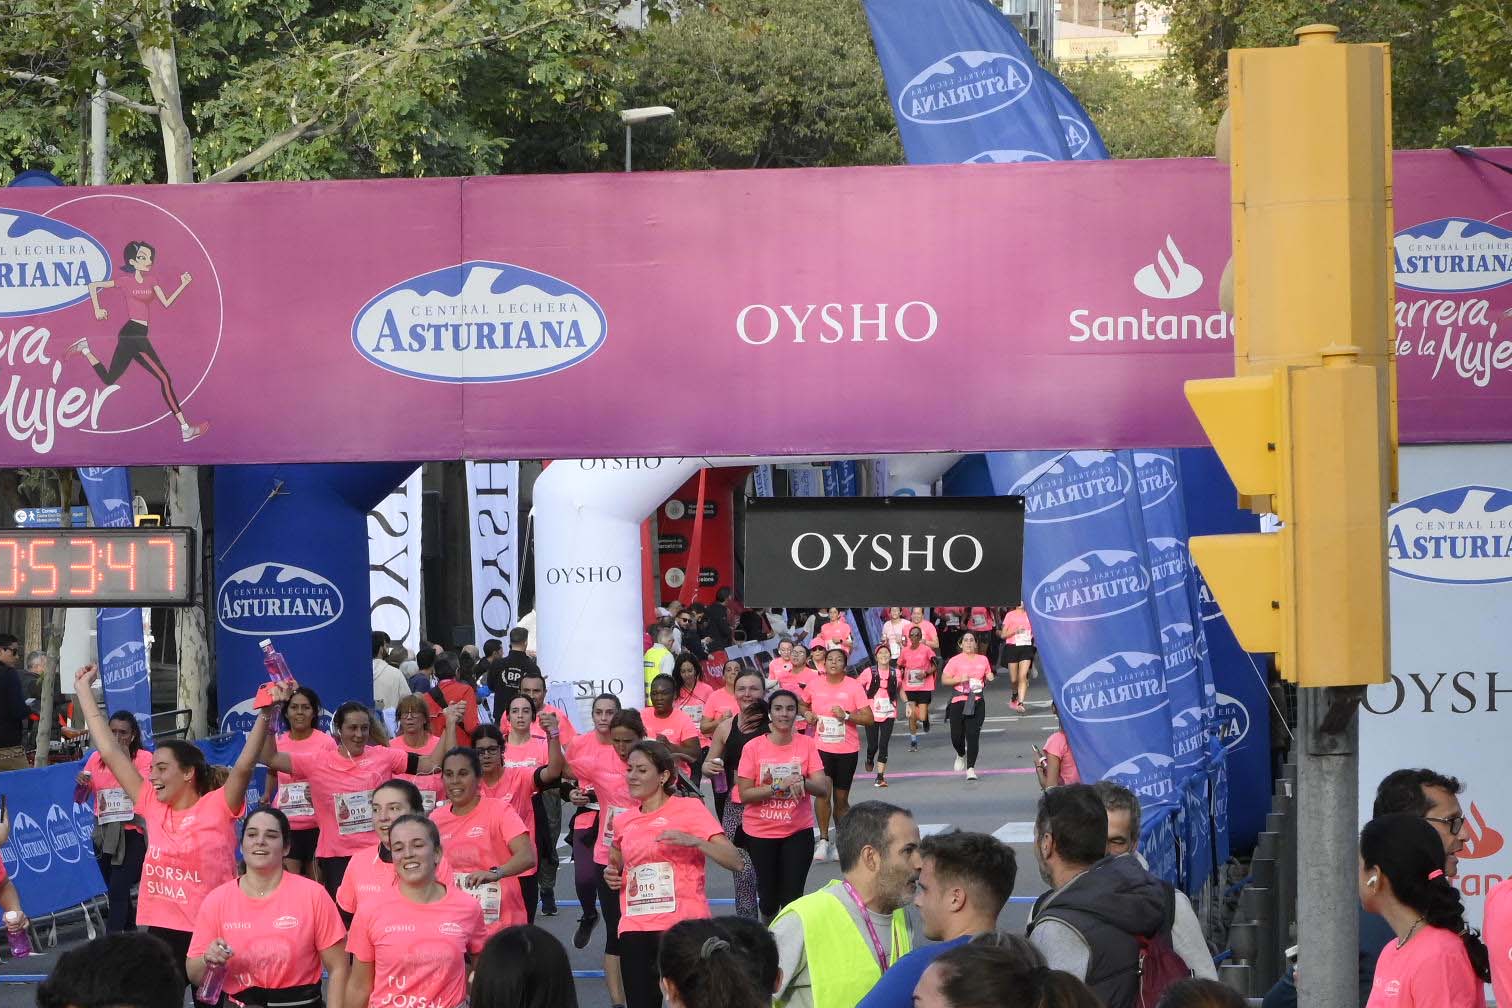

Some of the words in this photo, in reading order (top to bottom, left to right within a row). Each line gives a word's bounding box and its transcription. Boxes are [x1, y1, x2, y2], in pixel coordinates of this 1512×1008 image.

[14, 245, 87, 256] LECHERA
[1408, 243, 1458, 252] CENTRAL
[1466, 242, 1512, 251] LECHER
[411, 304, 489, 317] CENTRAL
[498, 302, 579, 314] LECHERA
[1394, 298, 1490, 327] arrera
[372, 308, 587, 353] ASTURIANA
[736, 301, 939, 344] OYSHO
[1418, 328, 1435, 356] la
[1416, 521, 1482, 531] CENTRAL
[791, 532, 984, 574] OYSHO
[546, 565, 622, 584] OYSHO
[234, 587, 276, 596] CENTRAL
[281, 586, 330, 596] LECHERA
[221, 592, 334, 619] ASTURIANA
[508, 672, 521, 681] BP
[760, 809, 792, 821] SUMA
[147, 845, 161, 860] TU
[145, 863, 202, 883] DORSAL
[147, 881, 187, 899] SUMA
[639, 883, 655, 892] 016
